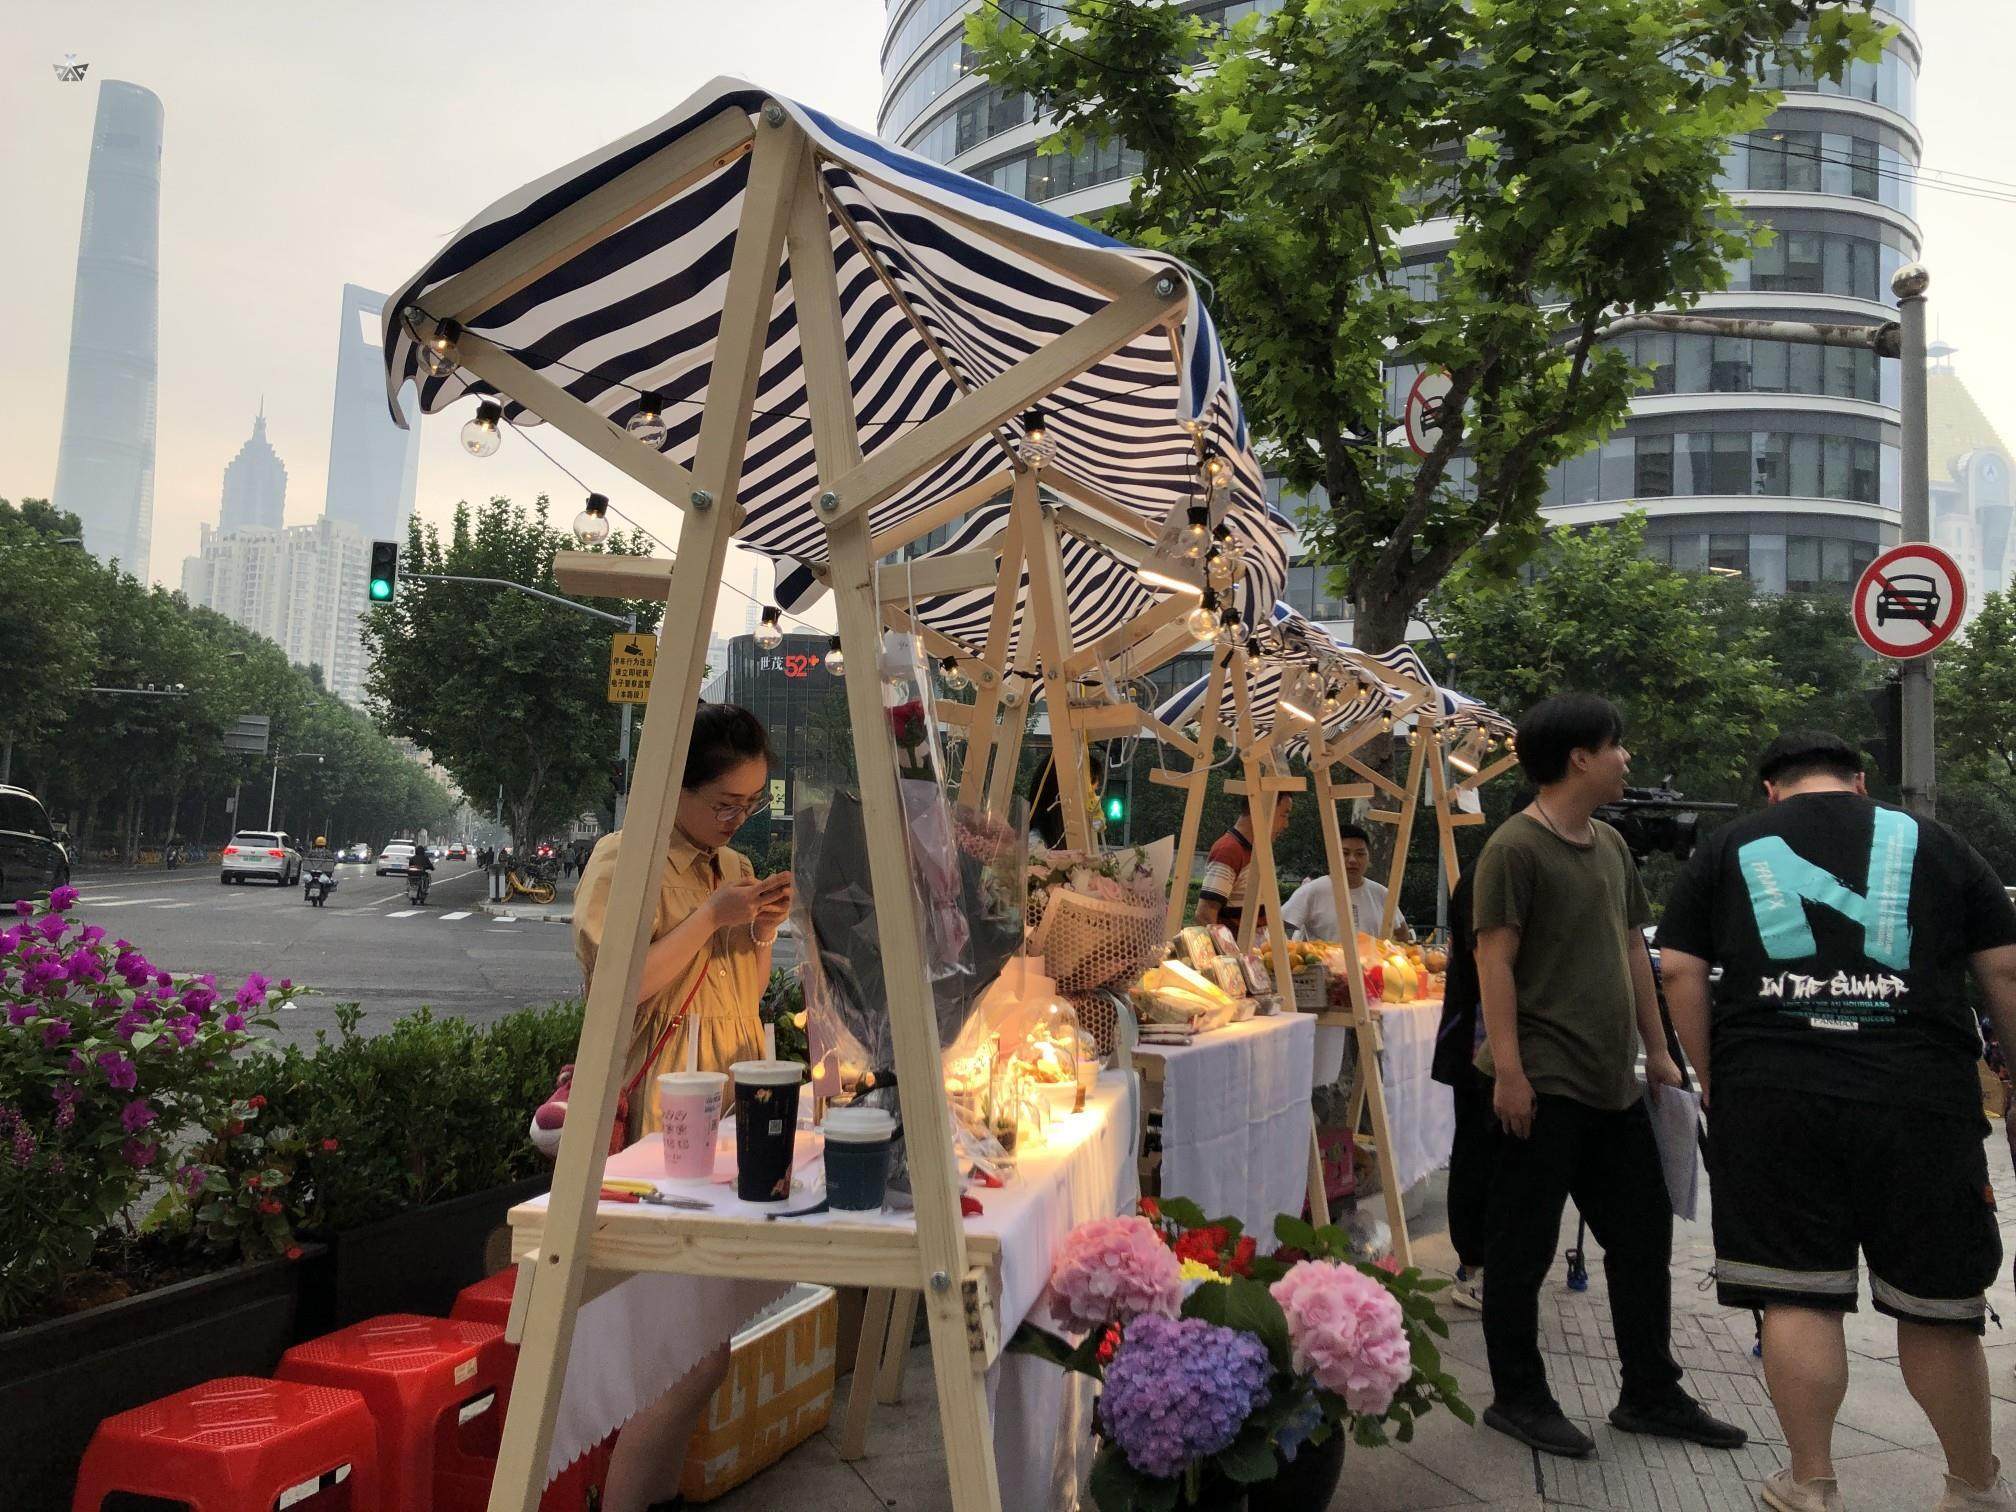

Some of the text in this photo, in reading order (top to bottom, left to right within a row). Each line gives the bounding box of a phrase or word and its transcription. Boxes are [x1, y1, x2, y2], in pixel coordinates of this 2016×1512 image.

[760, 656, 784, 671] 世茂
[1758, 970, 1909, 999] IN THE SUMMER
[1860, 1015, 1896, 1023] SUCCESS
